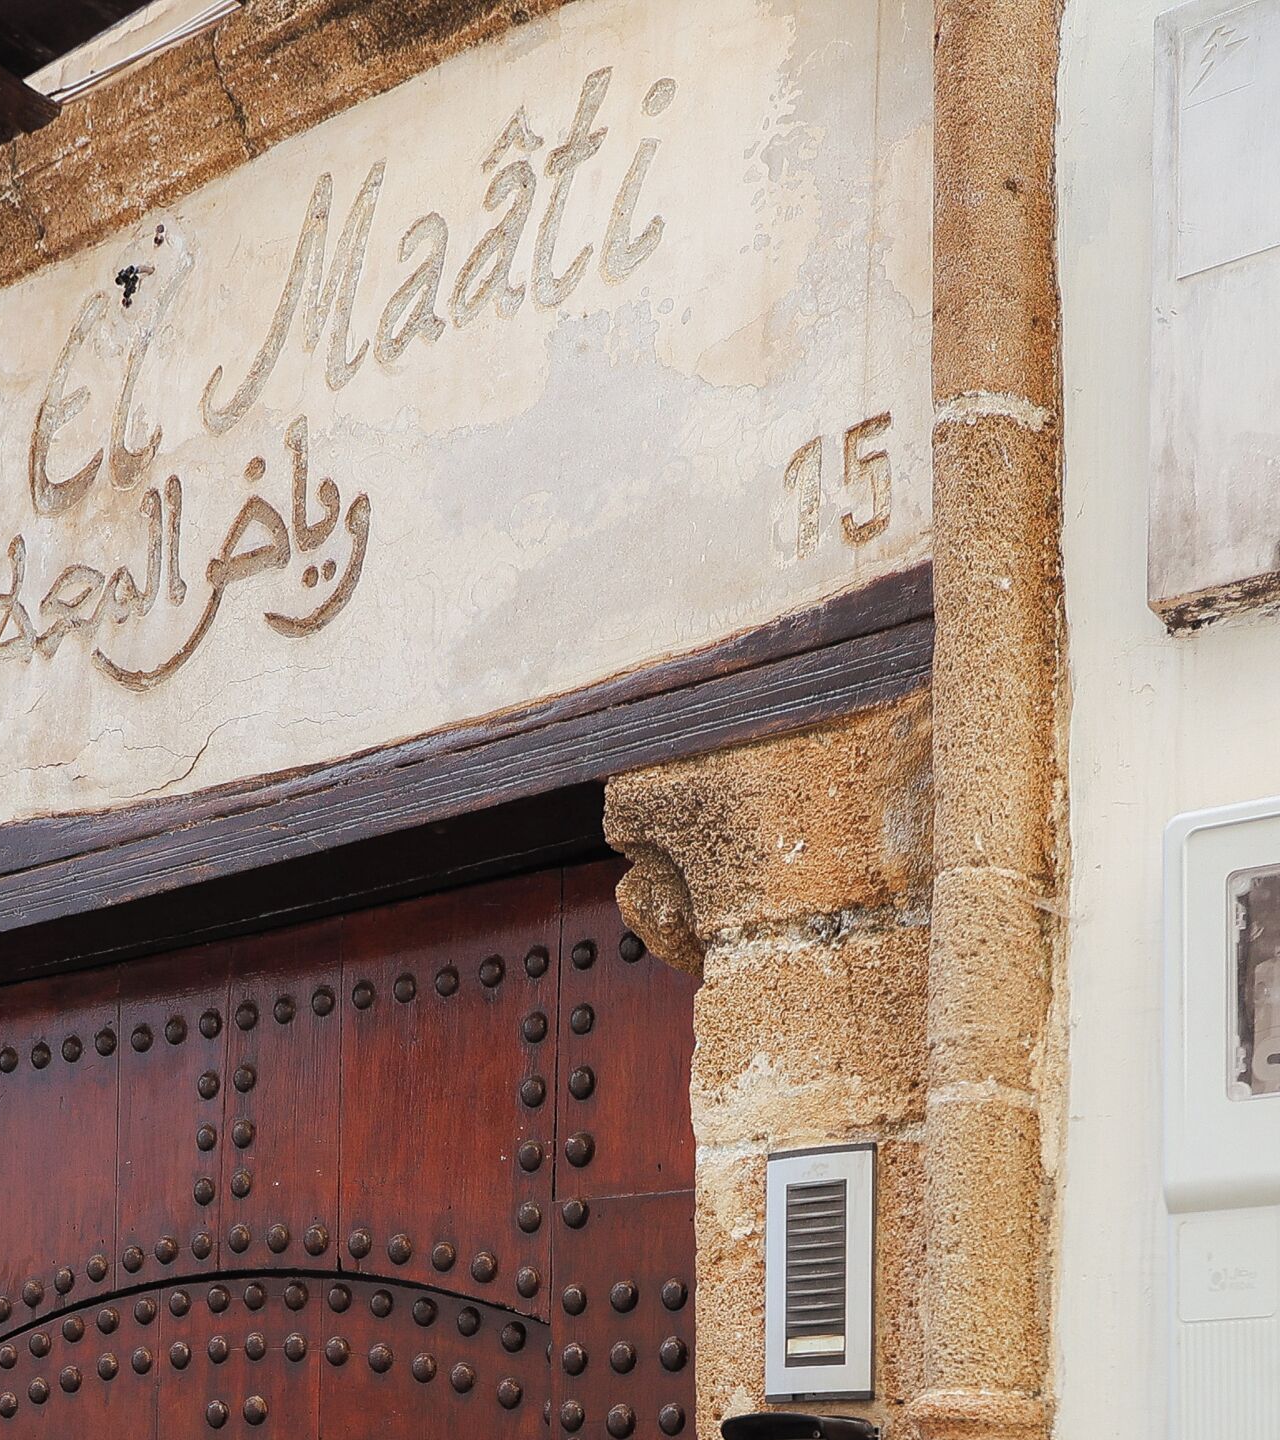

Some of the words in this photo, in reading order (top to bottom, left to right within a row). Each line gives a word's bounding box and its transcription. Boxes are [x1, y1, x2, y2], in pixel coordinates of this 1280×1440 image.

[30, 252, 193, 516] El
[202, 66, 677, 435] Maâti
[92, 415, 371, 692] رياض
[784, 410, 892, 560] 15
